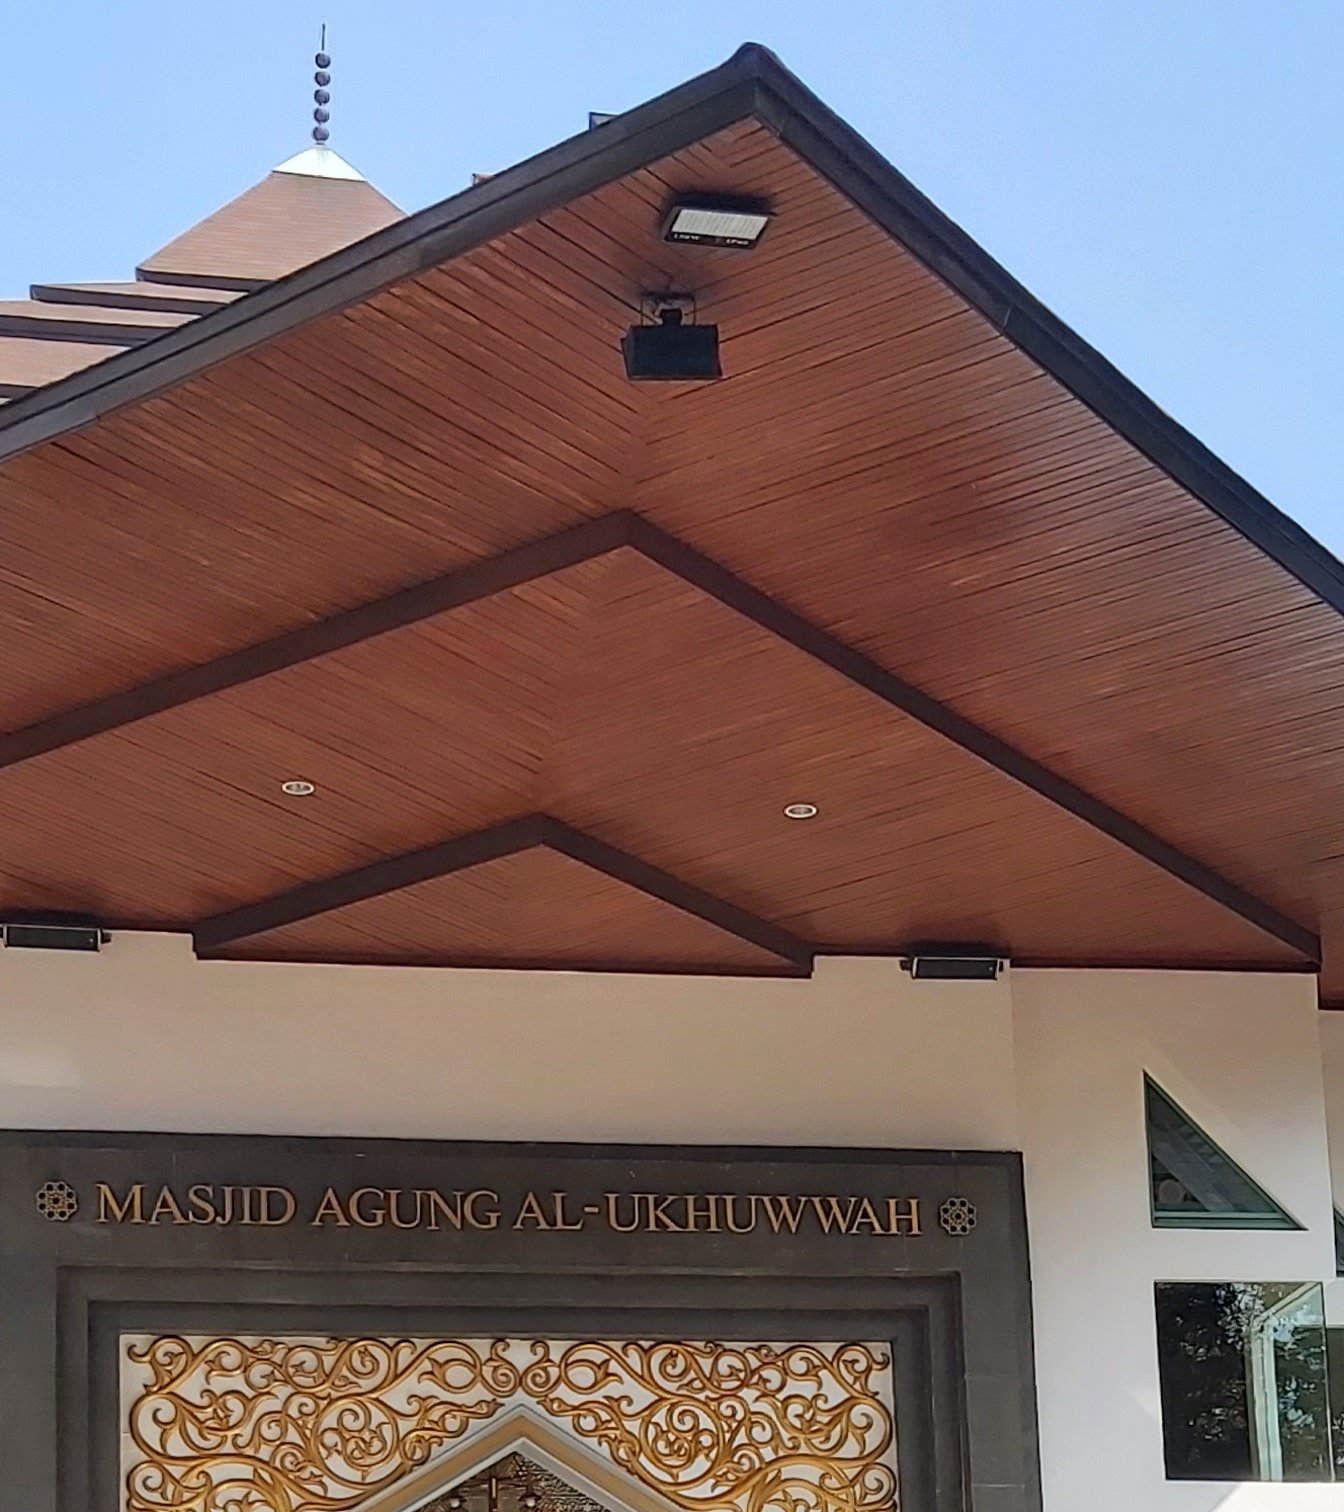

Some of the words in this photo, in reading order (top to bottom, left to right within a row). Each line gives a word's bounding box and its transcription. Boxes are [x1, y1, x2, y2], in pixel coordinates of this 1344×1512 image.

[95, 1183, 296, 1227] MASJID
[311, 1187, 502, 1231] AGUNG
[512, 1191, 923, 1236] AL-UKHUWWAH
